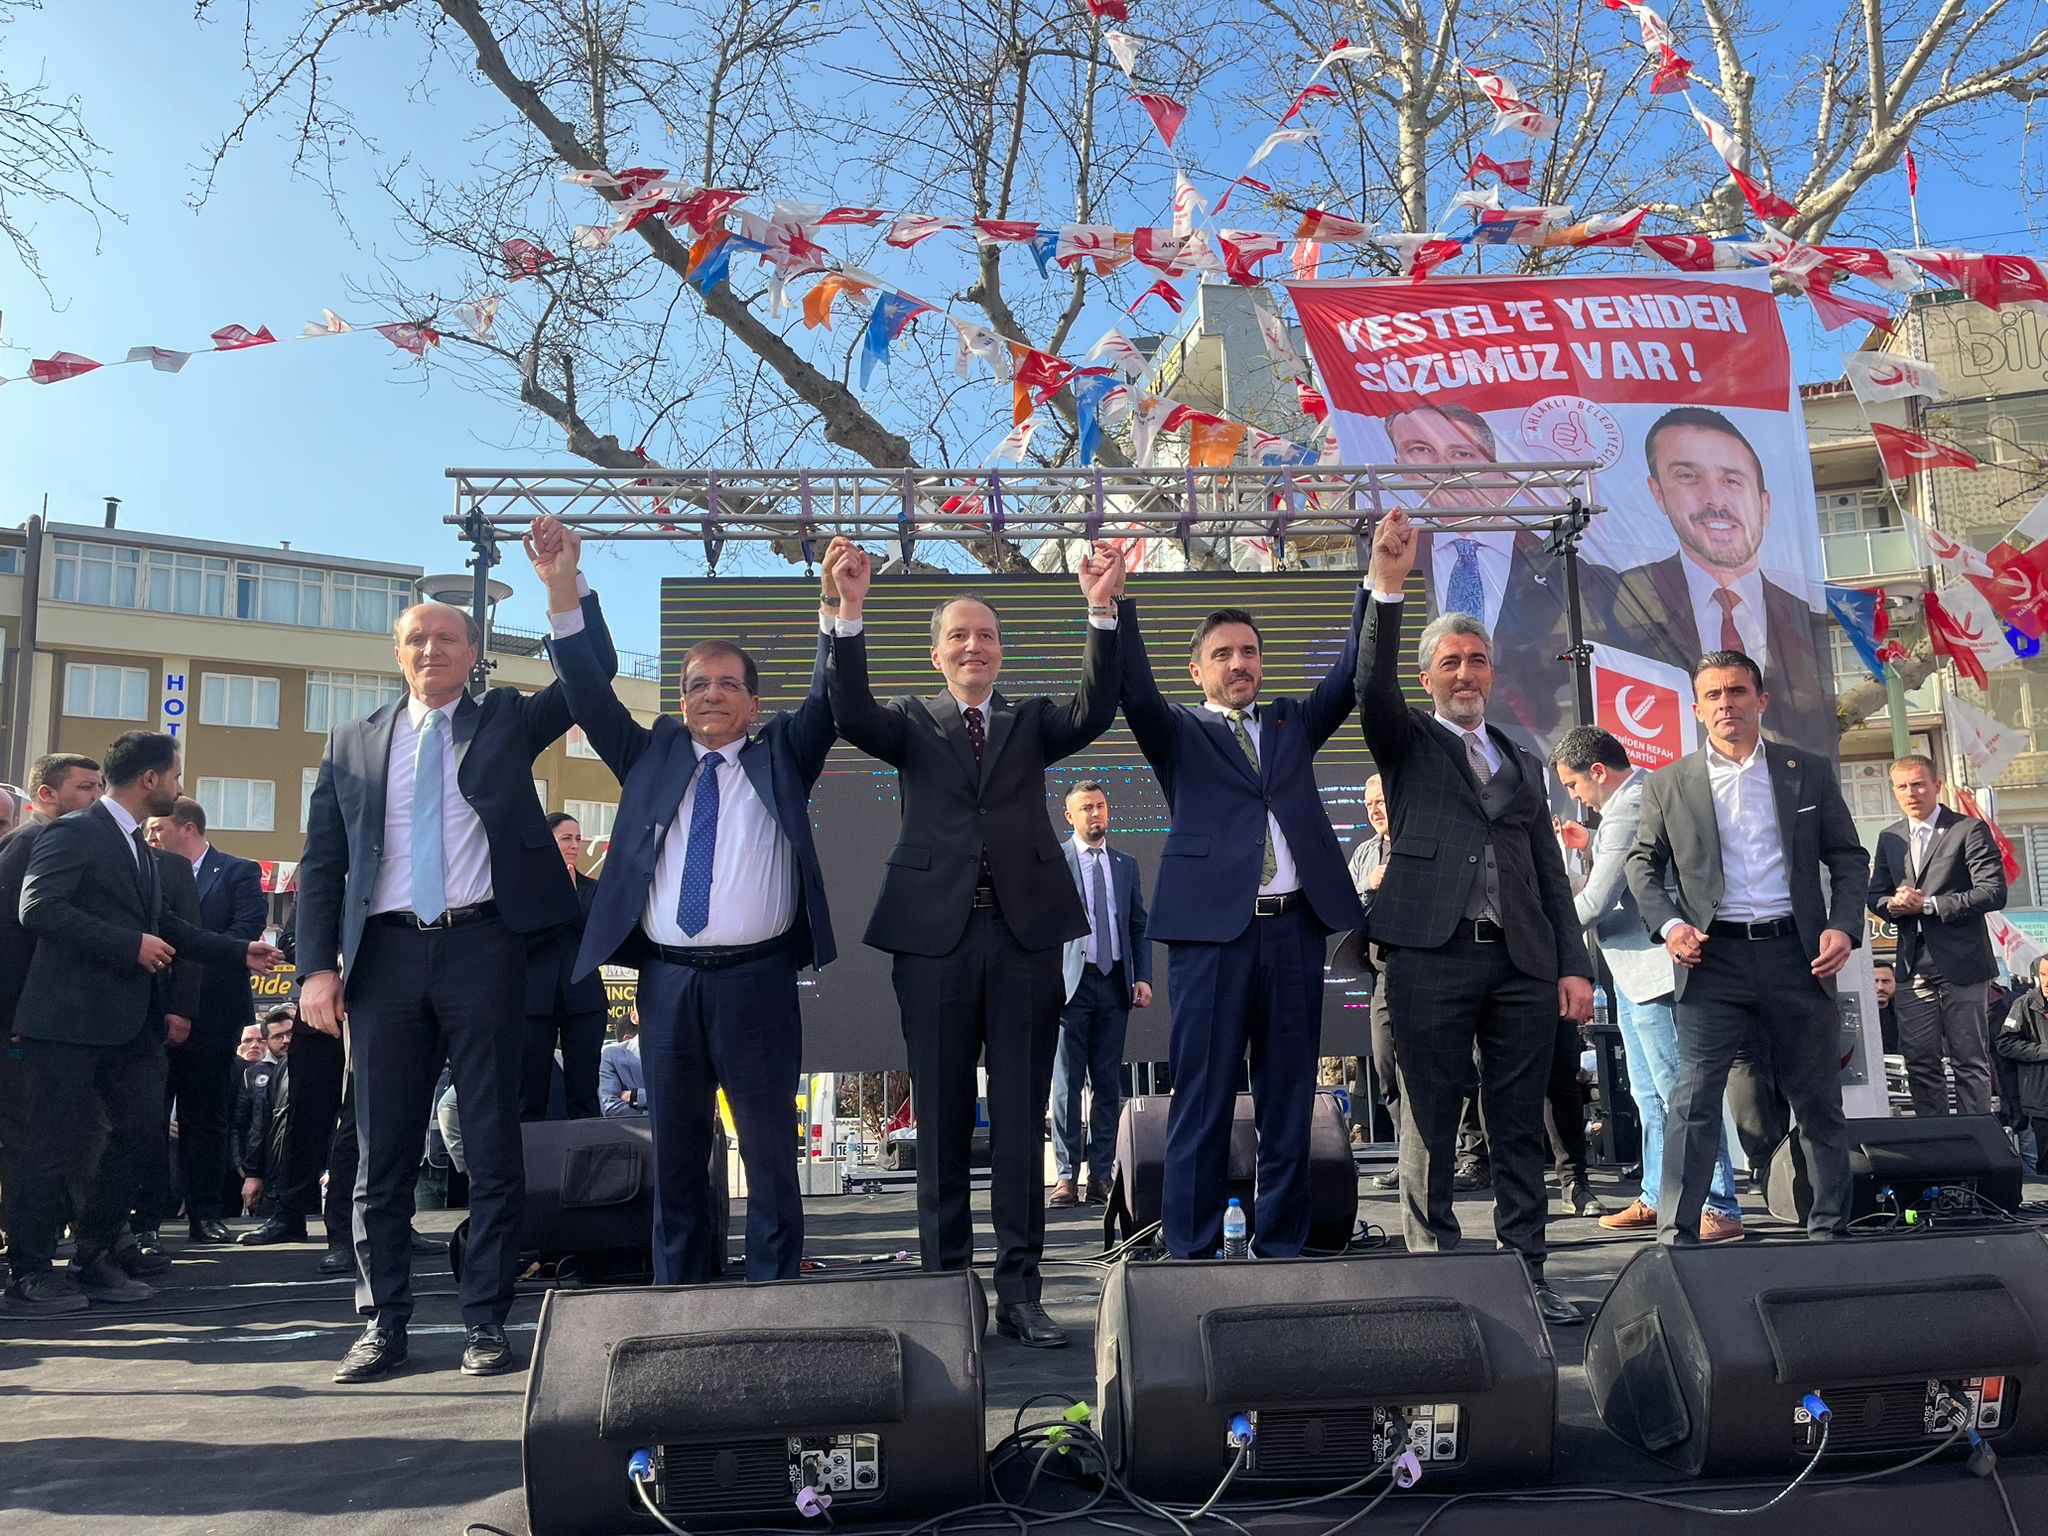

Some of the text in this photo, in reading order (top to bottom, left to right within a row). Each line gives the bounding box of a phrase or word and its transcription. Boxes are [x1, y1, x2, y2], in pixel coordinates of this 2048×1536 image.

[1955, 308, 2048, 381] bil
[1355, 343, 1569, 396] SÖZÜMÜZ
[1527, 399, 1567, 432] AHLAKLI
[165, 674, 185, 736] HOT
[1625, 748, 1656, 764] PARTİSİ
[1646, 744, 1674, 759] REFAH
[1923, 1405, 1932, 1422] 500
[1372, 1434, 1380, 1451] 500
[789, 1464, 797, 1482] 500
